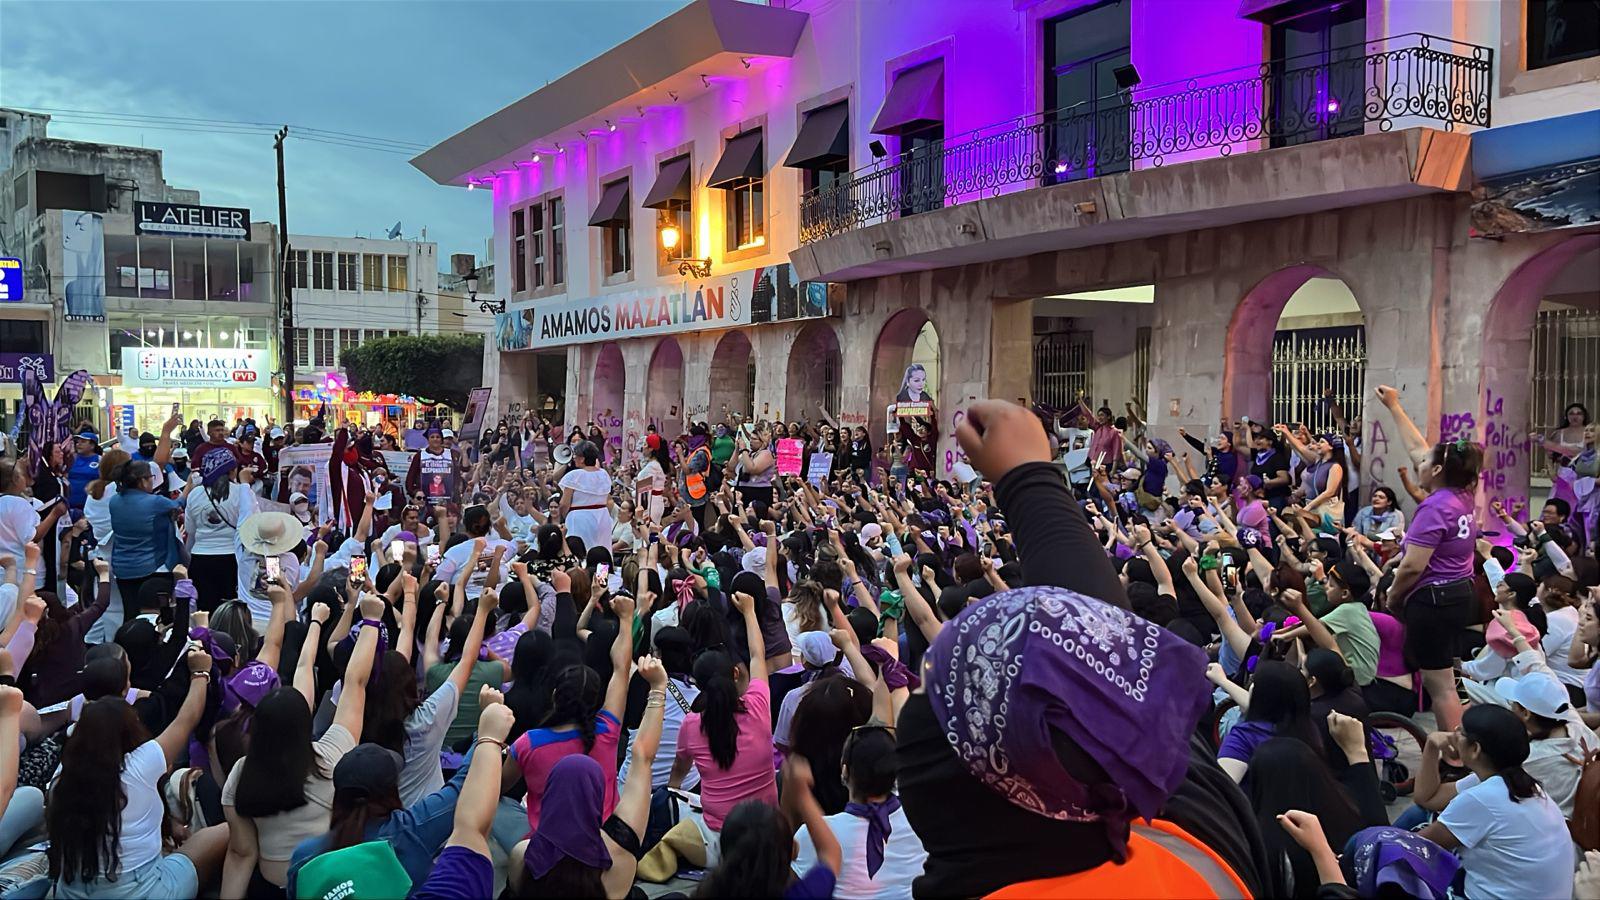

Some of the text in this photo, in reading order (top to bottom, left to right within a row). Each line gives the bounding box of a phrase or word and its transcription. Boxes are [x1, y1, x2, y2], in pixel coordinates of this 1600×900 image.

[191, 226, 241, 234] ACADEMY
[541, 285, 724, 339] AMAMOS MAZATLÁN
[162, 357, 249, 369] FARMACIA
[162, 370, 230, 378] PHARMACY
[234, 372, 256, 381] PVR
